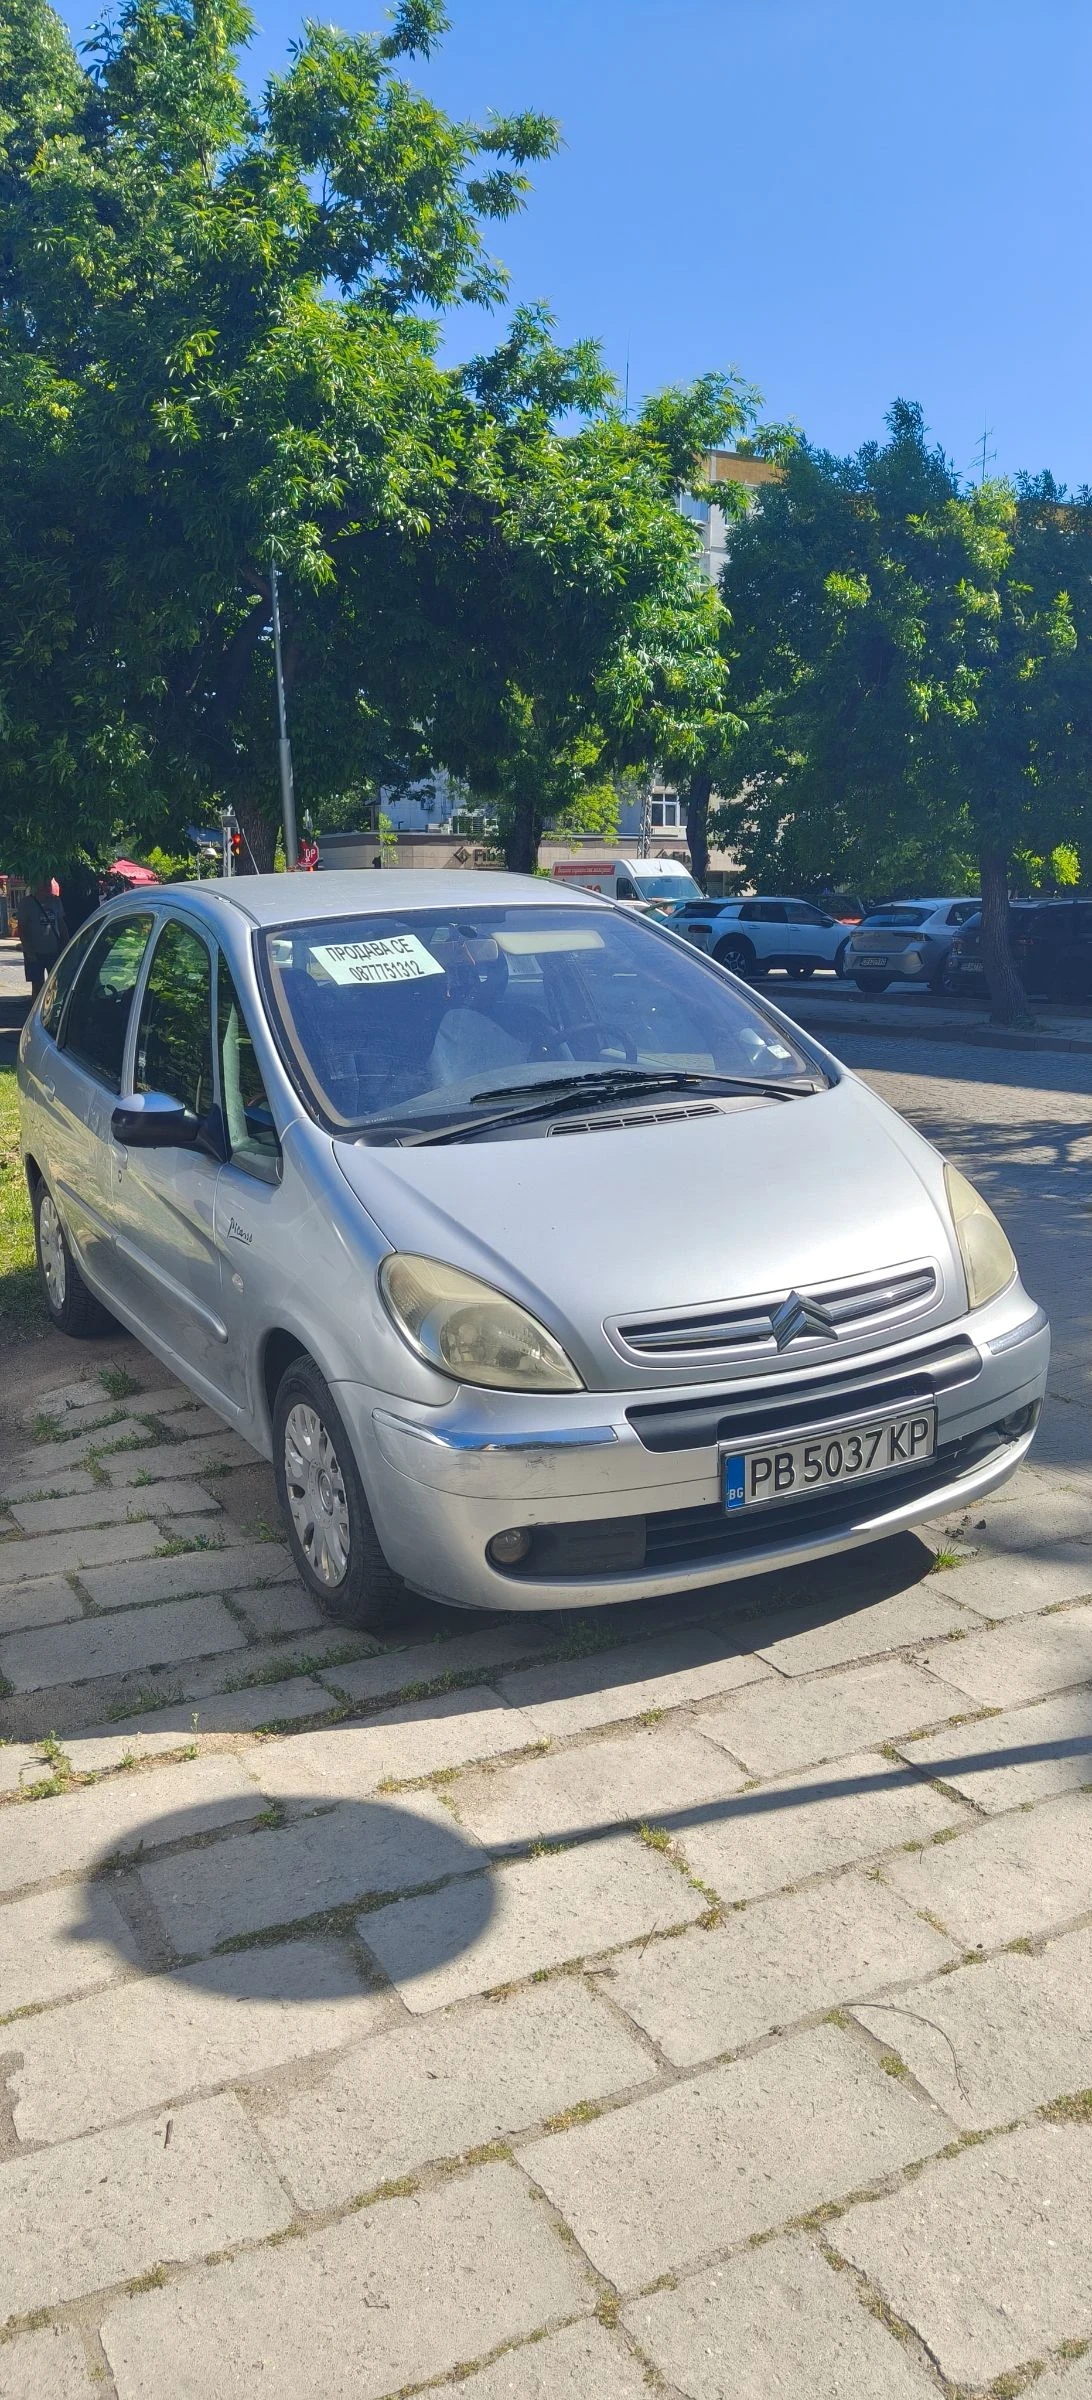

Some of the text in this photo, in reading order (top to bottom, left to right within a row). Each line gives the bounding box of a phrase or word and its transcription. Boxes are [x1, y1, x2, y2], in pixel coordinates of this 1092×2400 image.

[325, 938, 414, 962] ПРОДАВА СЕ
[348, 960, 425, 982] 0877751312
[751, 1418, 929, 1497] PB 5037 KP
[729, 1487, 744, 1500] BG
